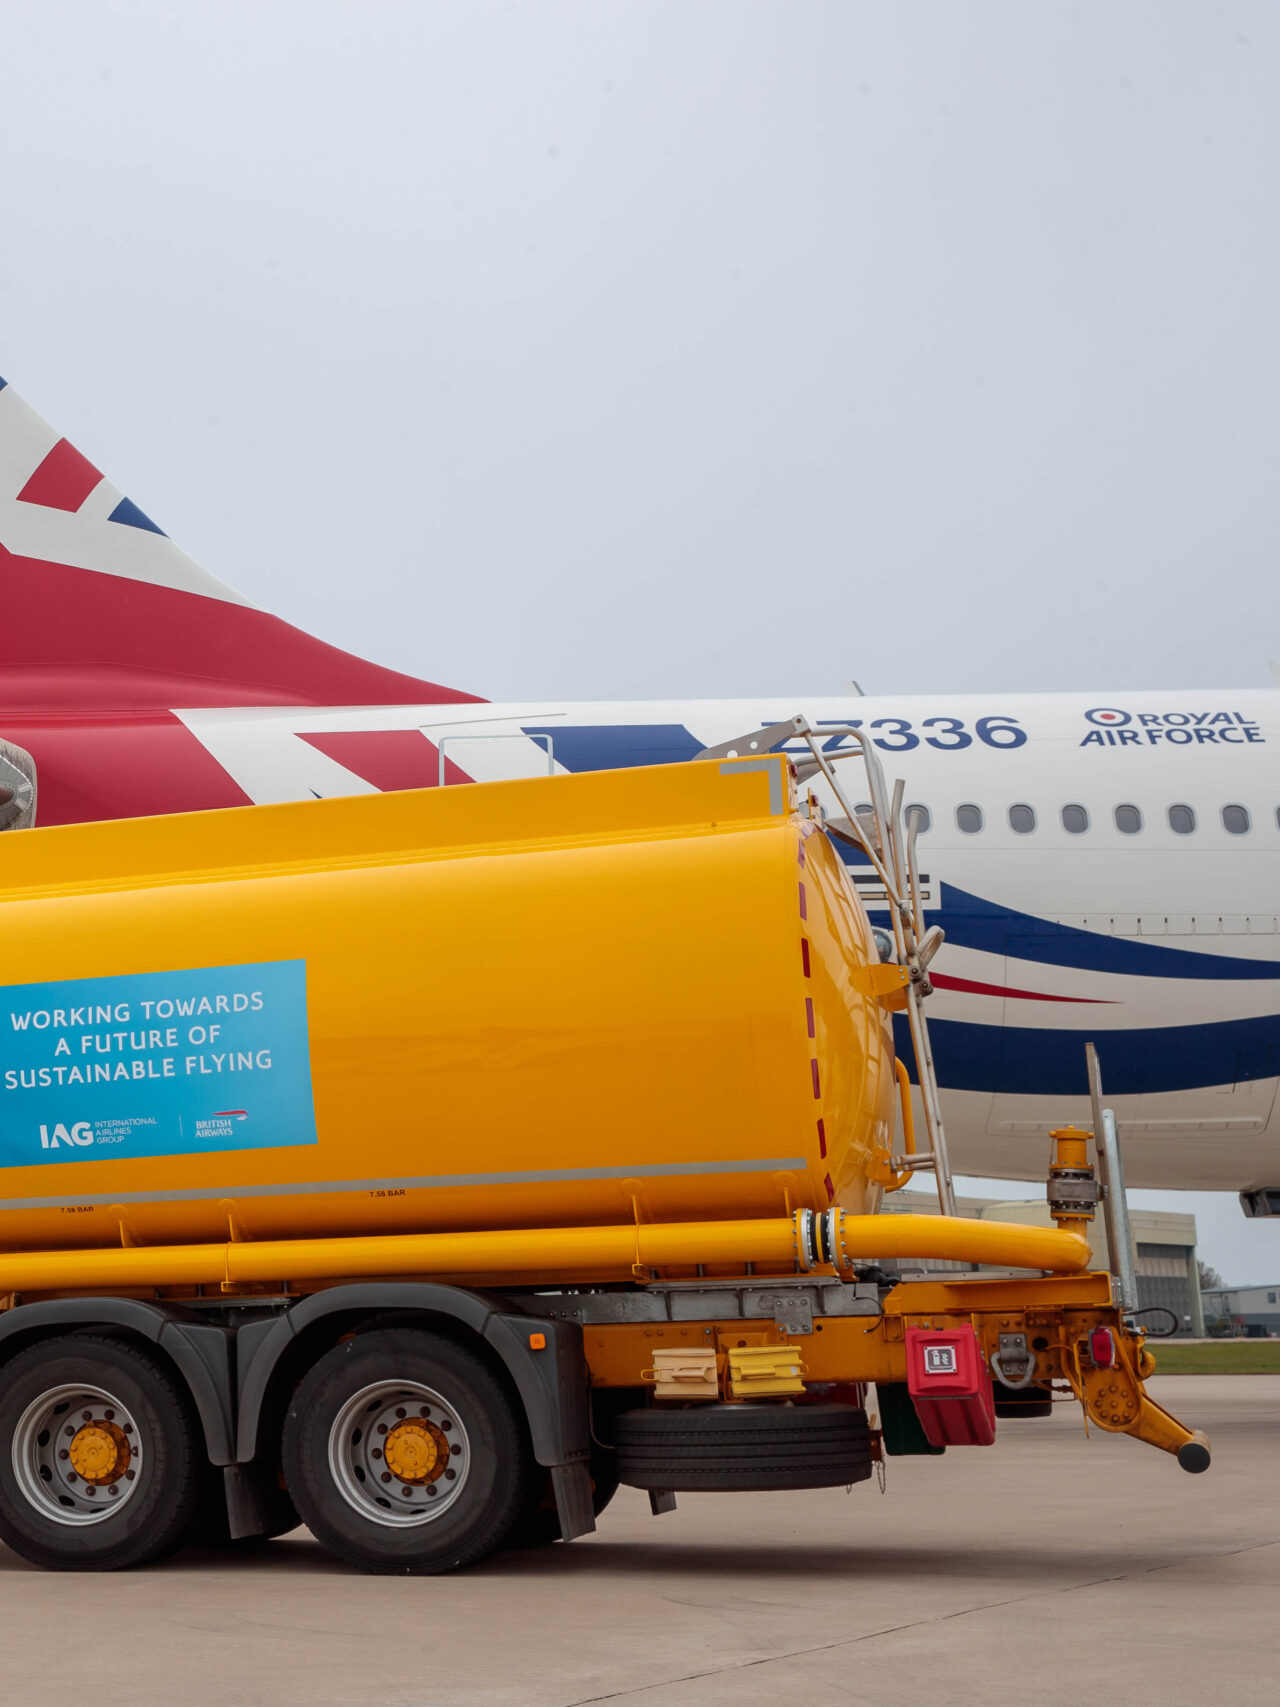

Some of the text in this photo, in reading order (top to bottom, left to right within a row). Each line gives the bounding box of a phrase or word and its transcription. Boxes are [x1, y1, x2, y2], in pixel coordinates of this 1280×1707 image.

[1137, 712, 1257, 726] ROYAL
[1079, 727, 1266, 747] AIR FORCE
[10, 992, 264, 1031] WORKING TOWARDS
[54, 1025, 221, 1057] A FUTURE OF
[4, 1050, 272, 1090] SUSTAINABLE FLYING
[95, 1117, 158, 1128] INTERNATIONAL
[195, 1119, 232, 1130] BRITISH
[39, 1121, 94, 1149] IAG
[95, 1126, 132, 1136] AIRLINES
[195, 1128, 233, 1138] AIRWAYS
[96, 1135, 125, 1145] GROUP
[387, 1189, 406, 1197] BAR
